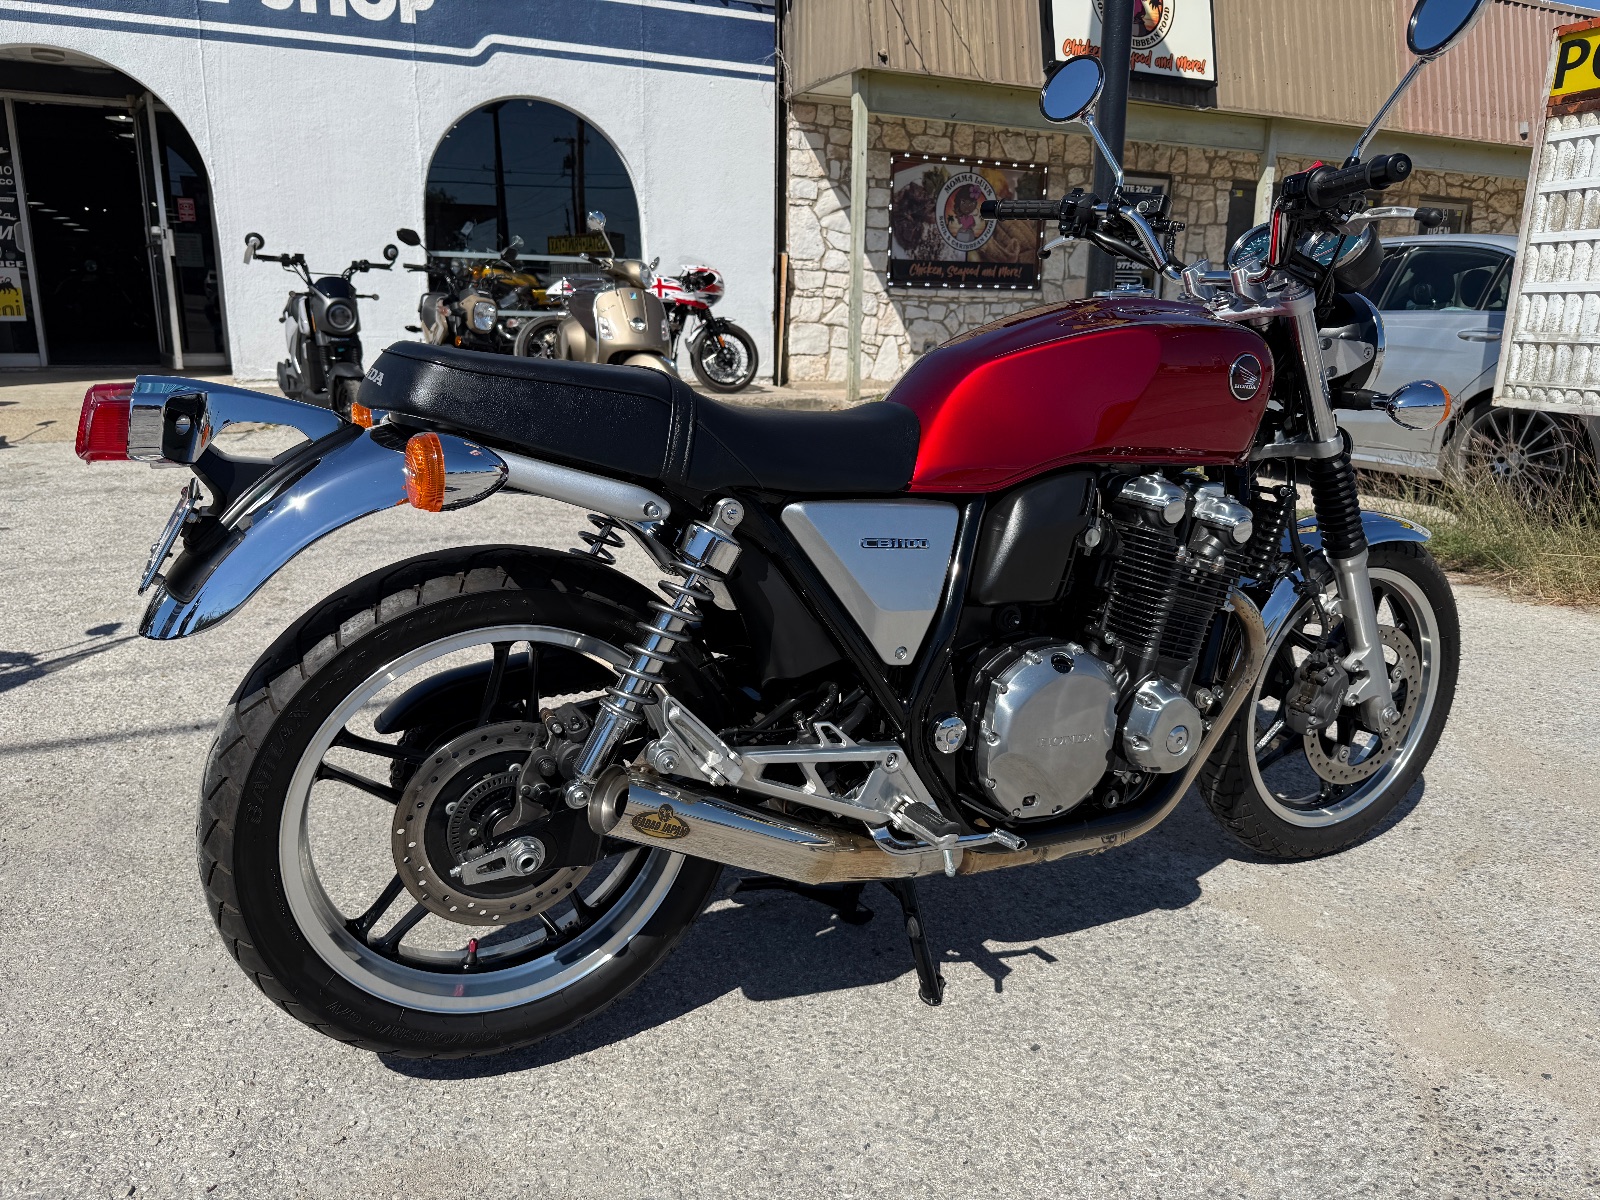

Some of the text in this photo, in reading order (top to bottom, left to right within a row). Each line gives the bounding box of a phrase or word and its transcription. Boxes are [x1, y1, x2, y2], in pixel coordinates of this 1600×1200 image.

[1159, 6, 1170, 34] FOOD
[1130, 49, 1152, 71] food
[1154, 53, 1173, 72] and
[1176, 55, 1206, 75] More!
[944, 174, 973, 193] MOMMA
[1135, 185, 1153, 193] 2427
[951, 237, 985, 250] CARIBBEAN
[909, 262, 1022, 281] Chicken, Seafood and More!
[860, 538, 930, 549] CB1100
[1037, 732, 1098, 748] HONDA
